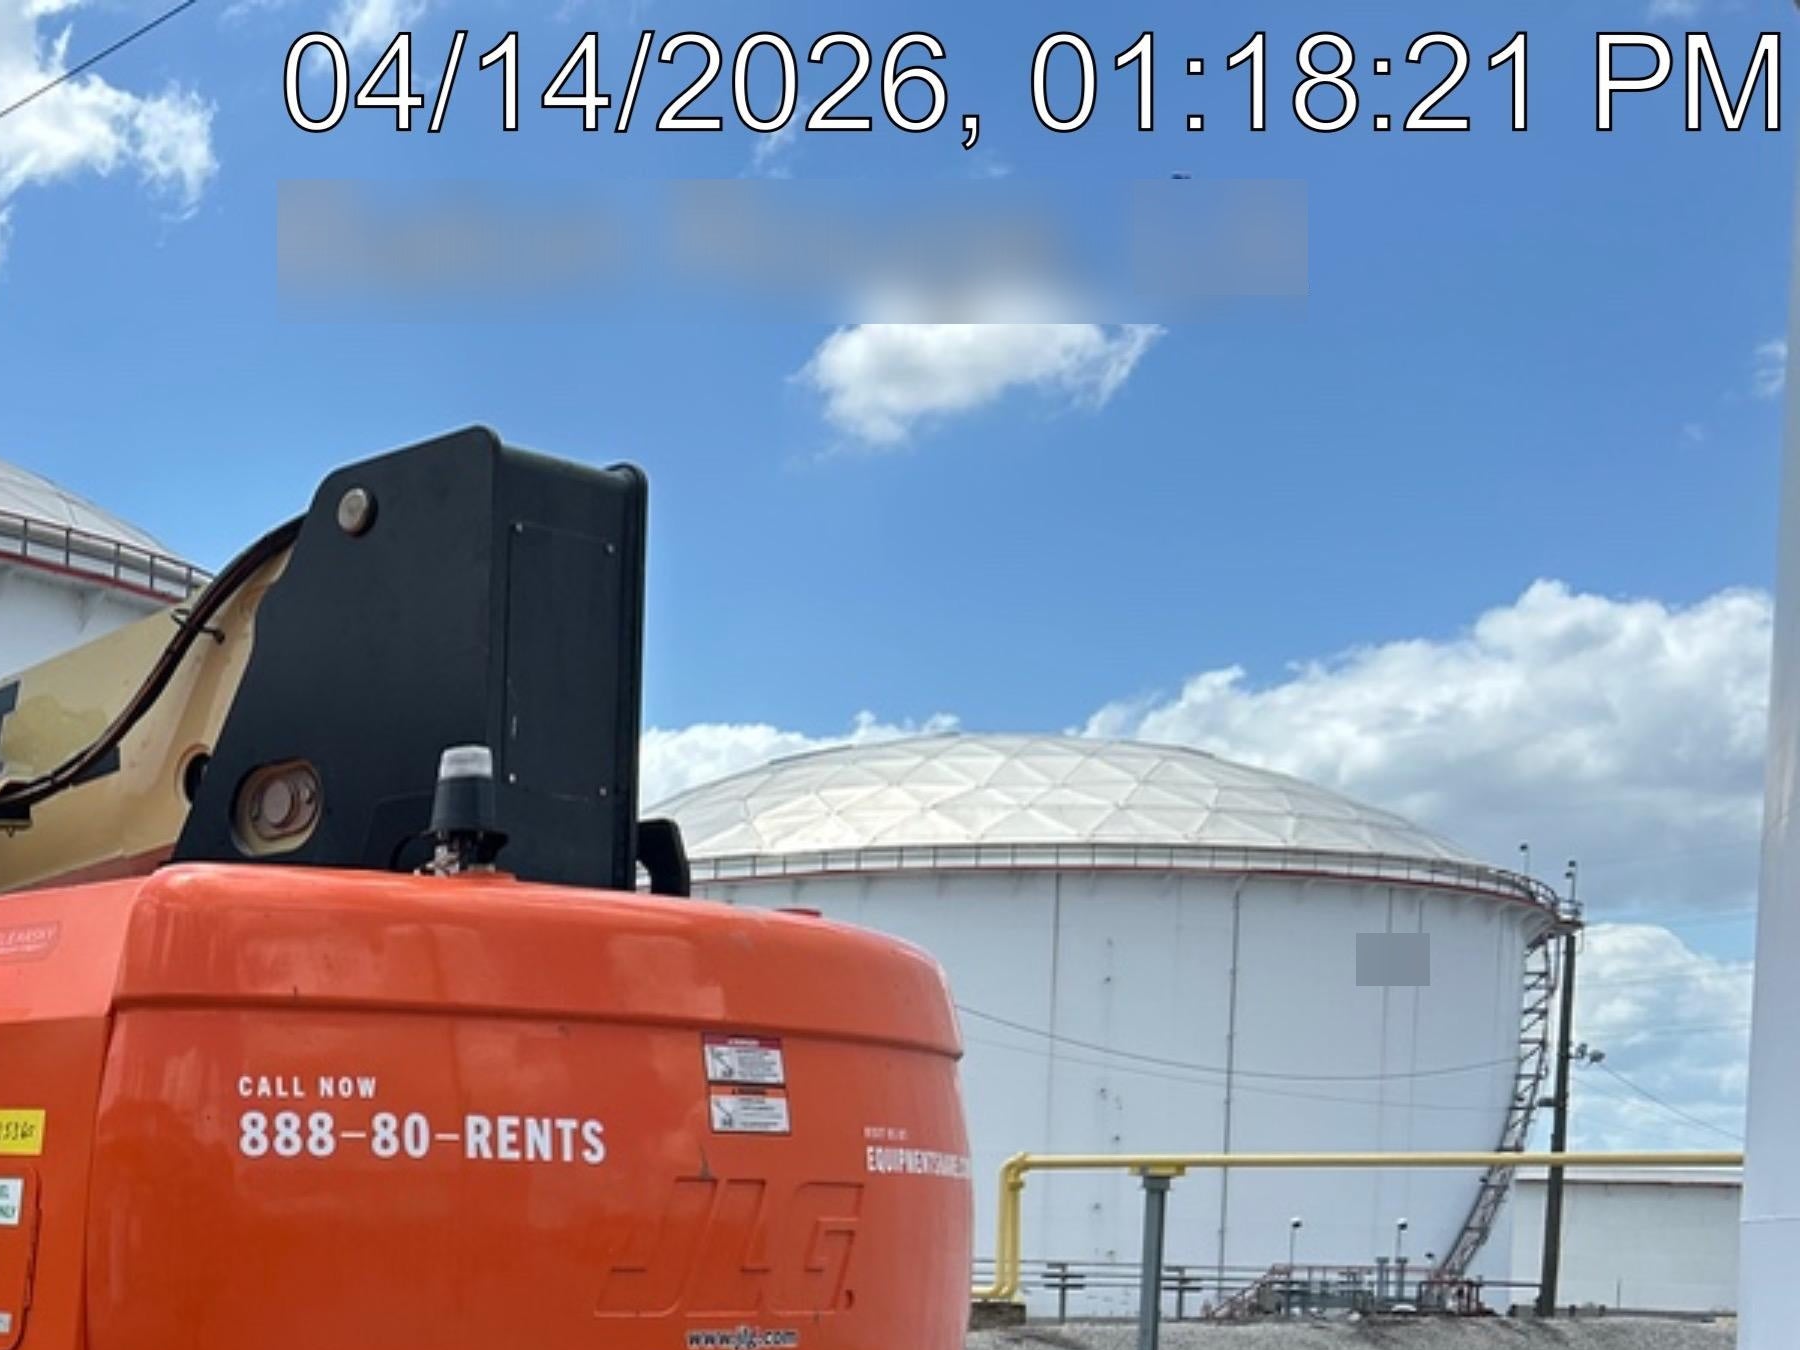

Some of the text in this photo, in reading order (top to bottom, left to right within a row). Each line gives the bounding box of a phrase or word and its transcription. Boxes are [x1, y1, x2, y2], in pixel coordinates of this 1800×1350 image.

[238, 1075, 377, 1099] CALL NOW
[238, 1110, 606, 1165] 888-80-RENTS
